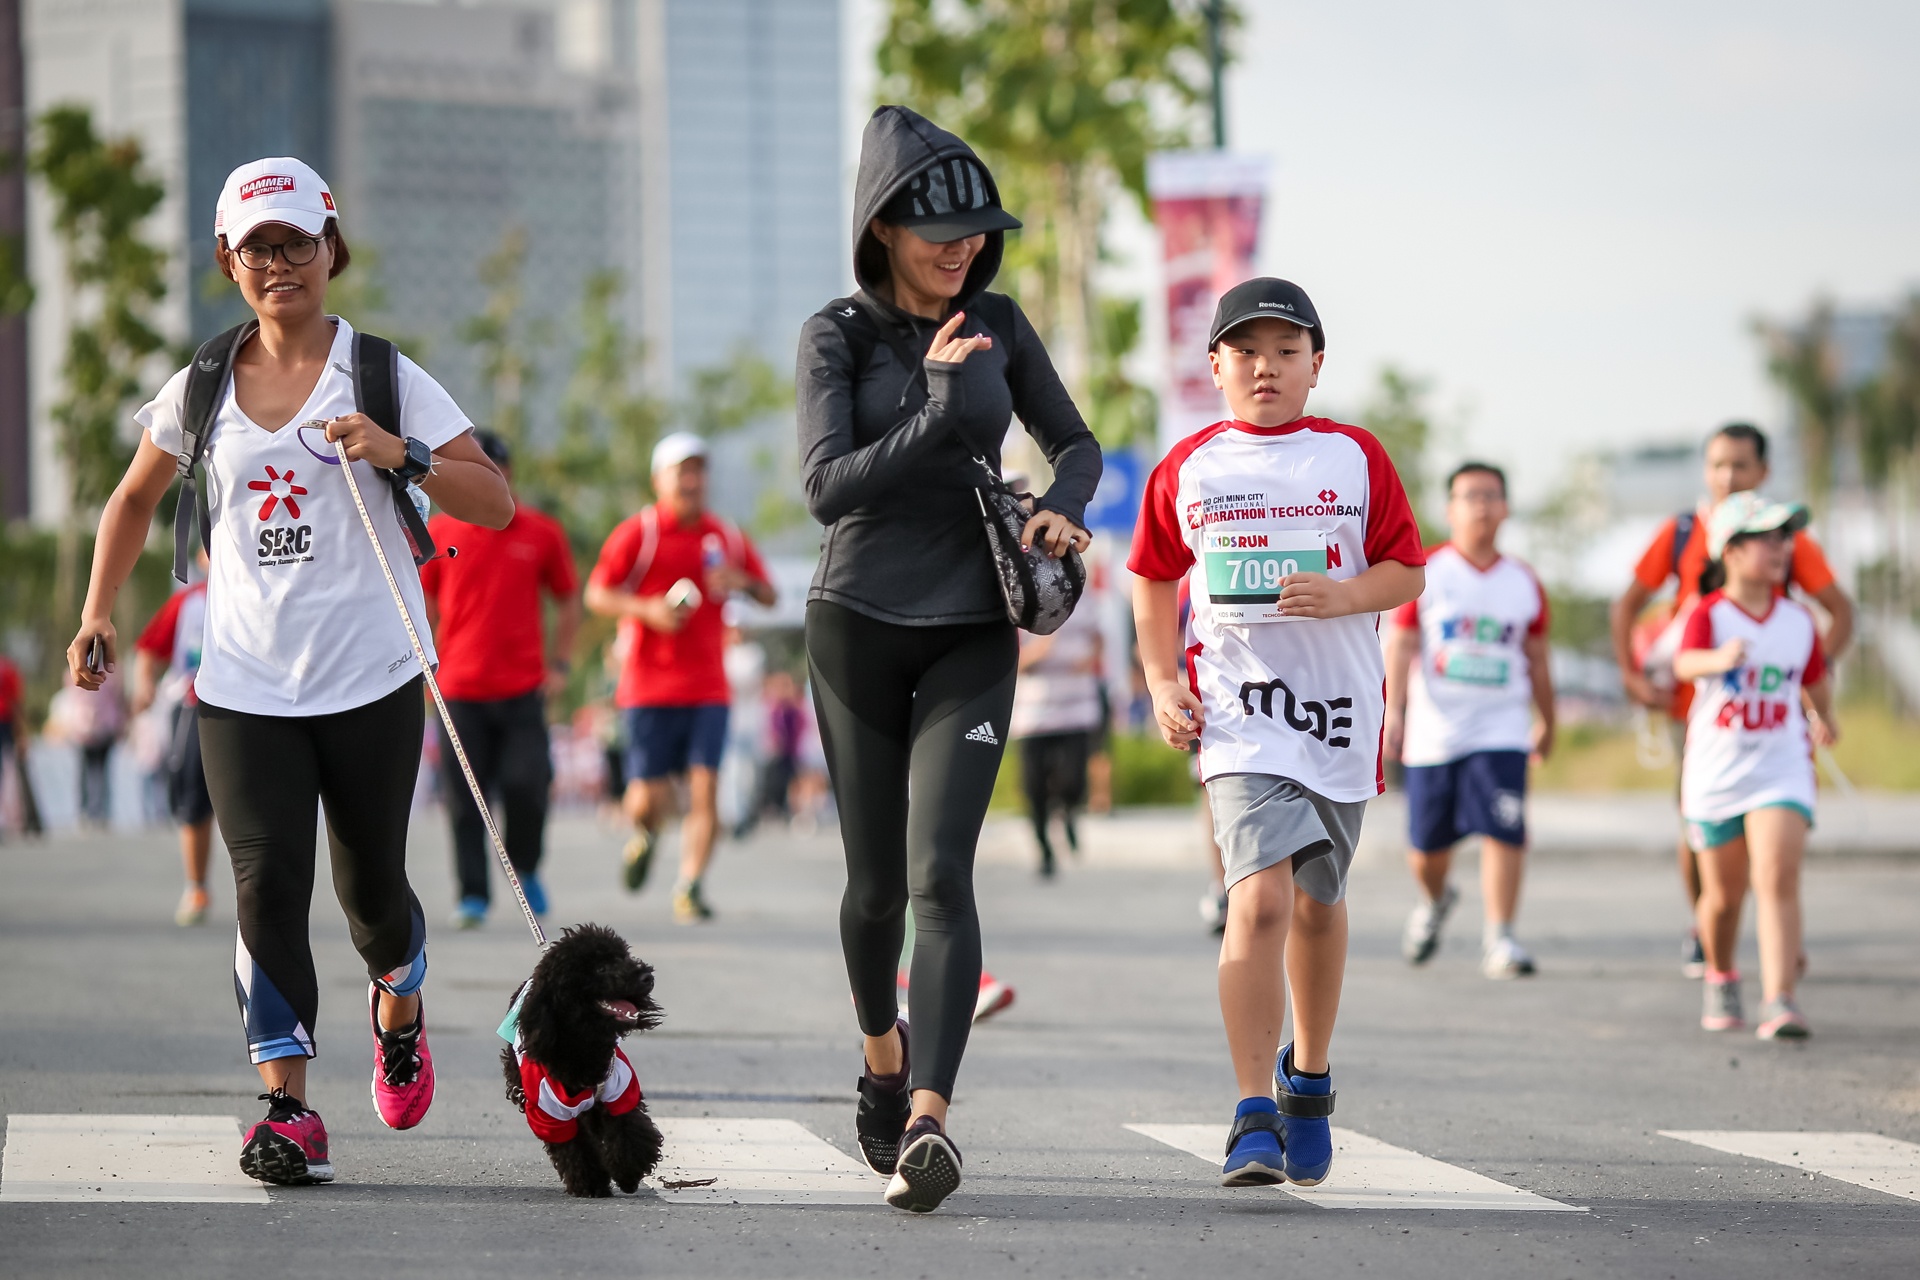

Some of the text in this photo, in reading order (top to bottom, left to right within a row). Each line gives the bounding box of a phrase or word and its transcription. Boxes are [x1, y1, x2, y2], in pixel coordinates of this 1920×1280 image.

[241, 177, 292, 195] HAMMER
[252, 186, 283, 197] NUTRITION
[903, 158, 989, 216] RU
[1258, 302, 1286, 310] Reebok
[1203, 492, 1264, 506] HO CHI MINH CITY
[1203, 501, 1265, 513] INTERNATIONAL
[1269, 504, 1363, 518] TECHCOMBAN
[1204, 507, 1266, 525] MARATHON
[387, 649, 413, 674] 2XU
[965, 732, 999, 745] adidas
